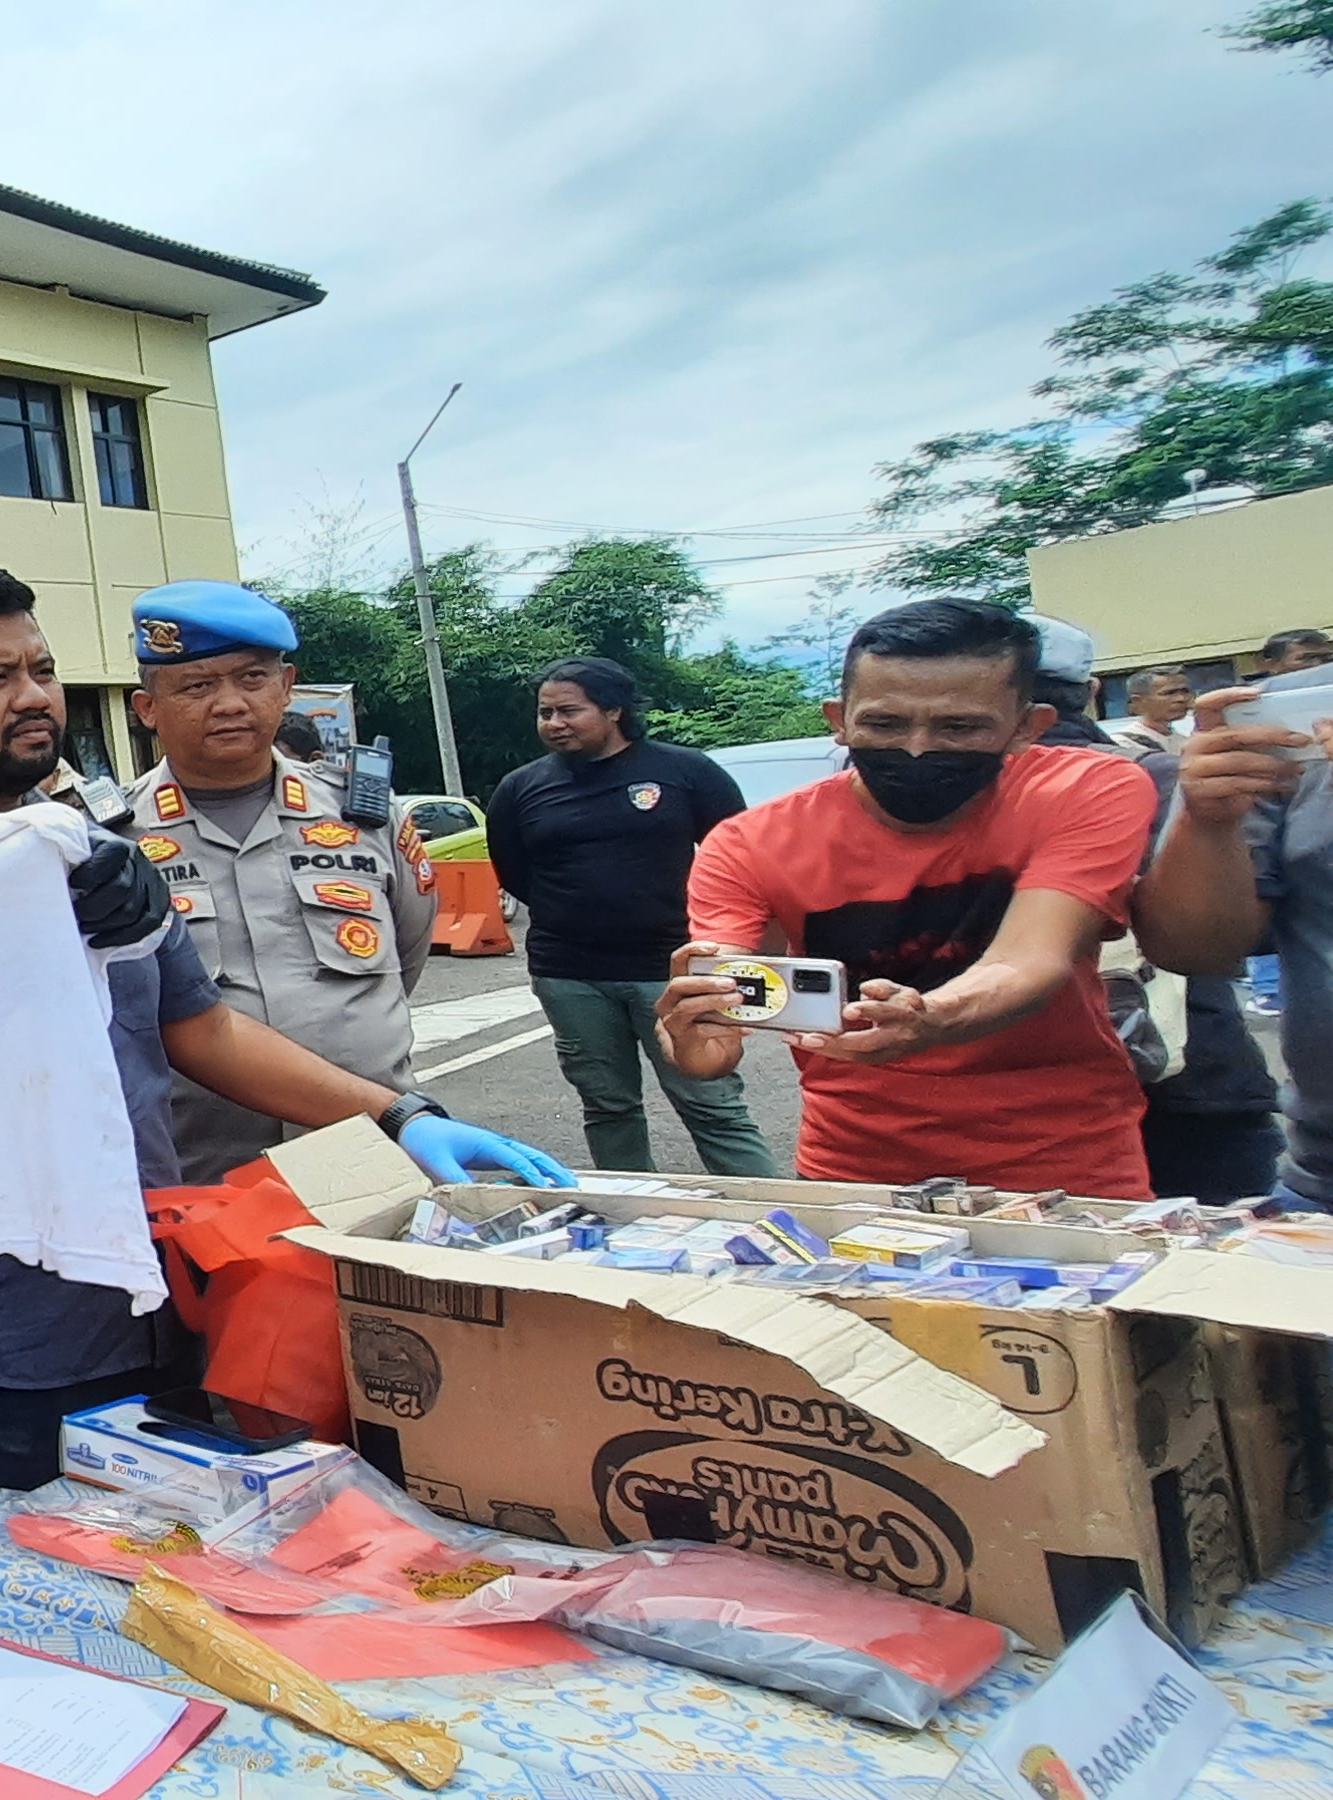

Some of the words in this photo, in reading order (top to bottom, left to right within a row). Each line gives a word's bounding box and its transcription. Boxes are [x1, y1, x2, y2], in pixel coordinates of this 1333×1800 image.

[159, 862, 201, 883] TIRA
[290, 853, 378, 875] POLRI
[596, 1358, 764, 1434] Kering
[1000, 1354, 1040, 1396] L
[391, 1392, 425, 1420] 12
[692, 1455, 835, 1513] pants
[1077, 1715, 1157, 1800] BARANG
[1143, 1672, 1198, 1736] BUKTI
